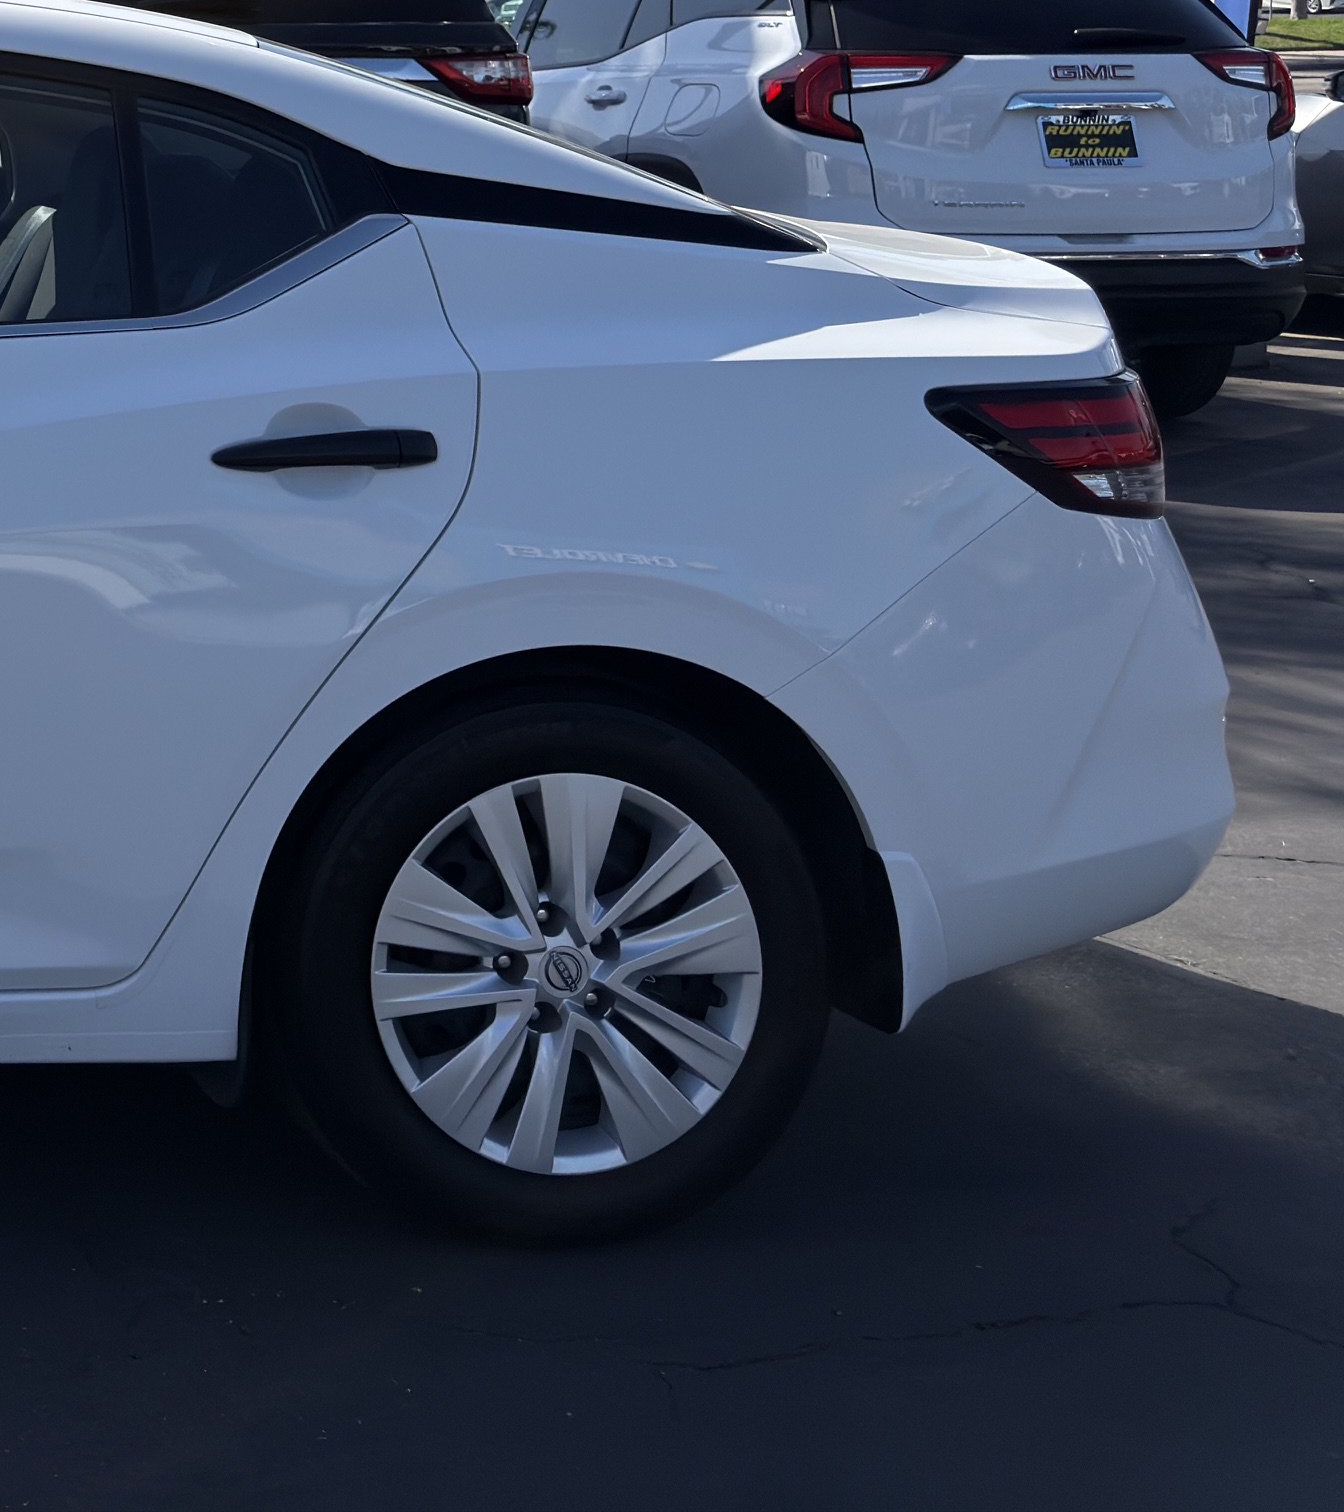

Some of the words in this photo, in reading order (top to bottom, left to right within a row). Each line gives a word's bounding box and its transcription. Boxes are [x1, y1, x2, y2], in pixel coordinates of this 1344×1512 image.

[1051, 64, 1135, 81] GMC
[1063, 115, 1110, 124] BUNNIN
[1045, 125, 1130, 135] RUNNIN'
[1080, 137, 1100, 145] to
[1049, 147, 1130, 158] BUNNIN
[552, 952, 576, 991] NISSAN
